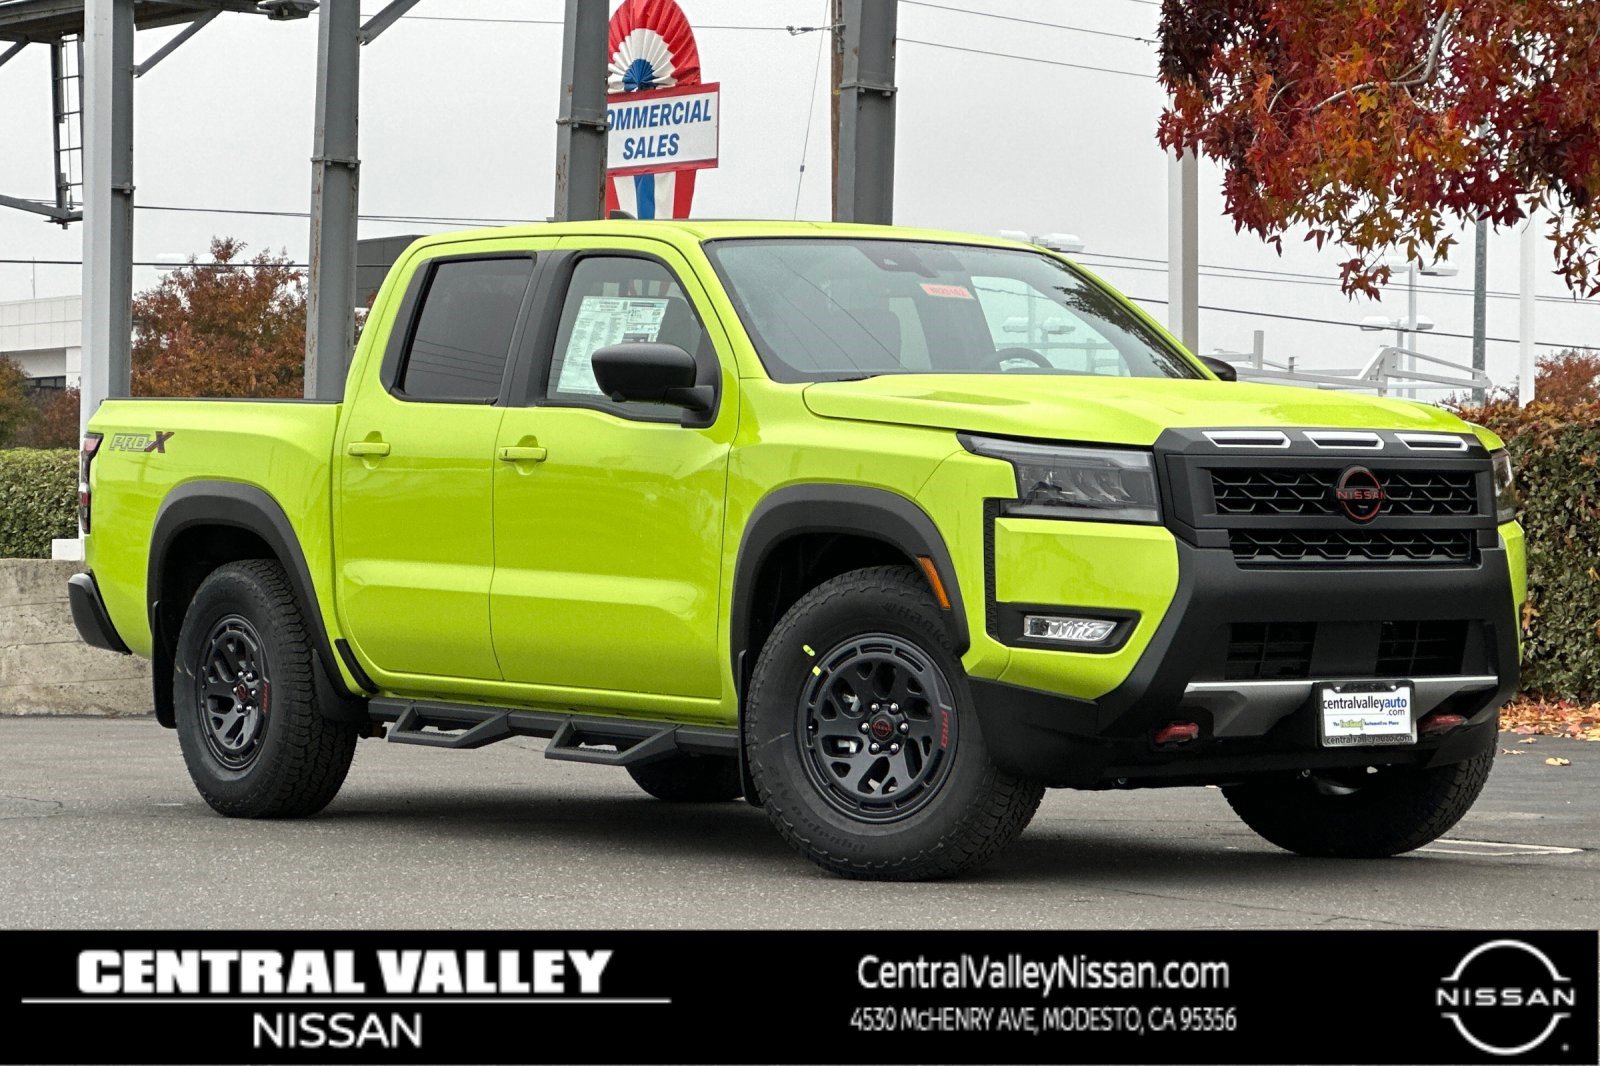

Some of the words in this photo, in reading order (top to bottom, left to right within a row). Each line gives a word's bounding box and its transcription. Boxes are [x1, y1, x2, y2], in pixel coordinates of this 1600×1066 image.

[607, 99, 711, 131] OMMERCIAL
[623, 133, 680, 160] SALES
[1336, 490, 1386, 500] NISSAN
[1323, 696, 1407, 712] centralvalleyauto
